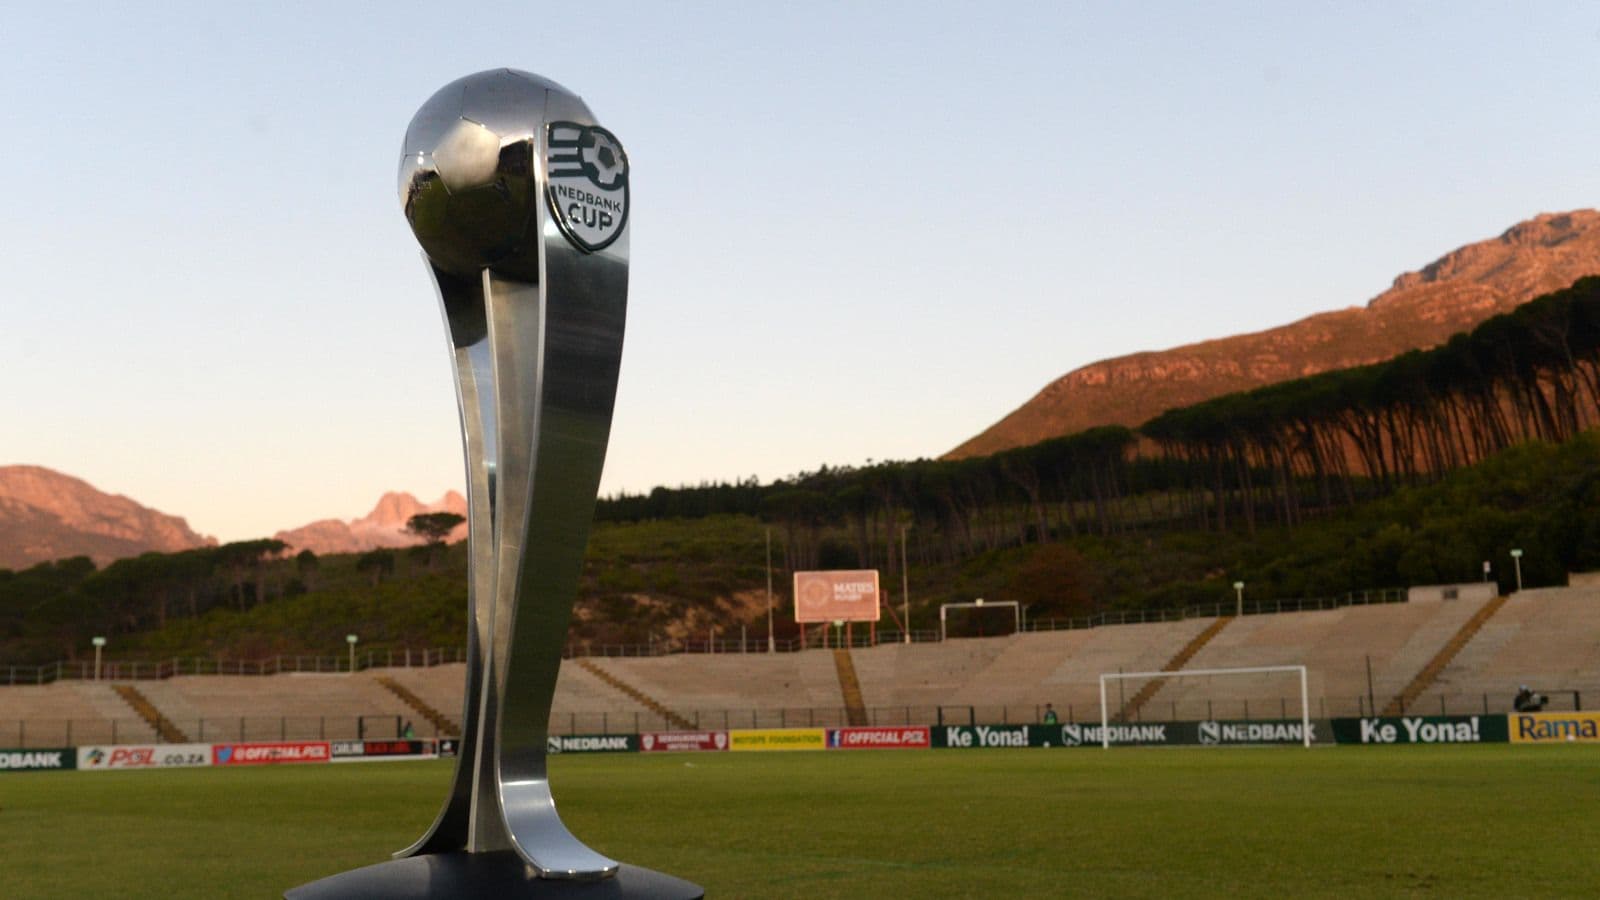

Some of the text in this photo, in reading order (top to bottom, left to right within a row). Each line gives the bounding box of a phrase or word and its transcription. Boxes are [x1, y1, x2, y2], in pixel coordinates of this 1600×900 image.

[558, 184, 621, 213] NEDBANK
[568, 203, 613, 231] CUP
[947, 725, 1030, 747] Ke Yona!
[1360, 716, 1480, 743] Ke Yona!
[1519, 715, 1597, 741] Rama
[563, 737, 629, 750] NEDBANK
